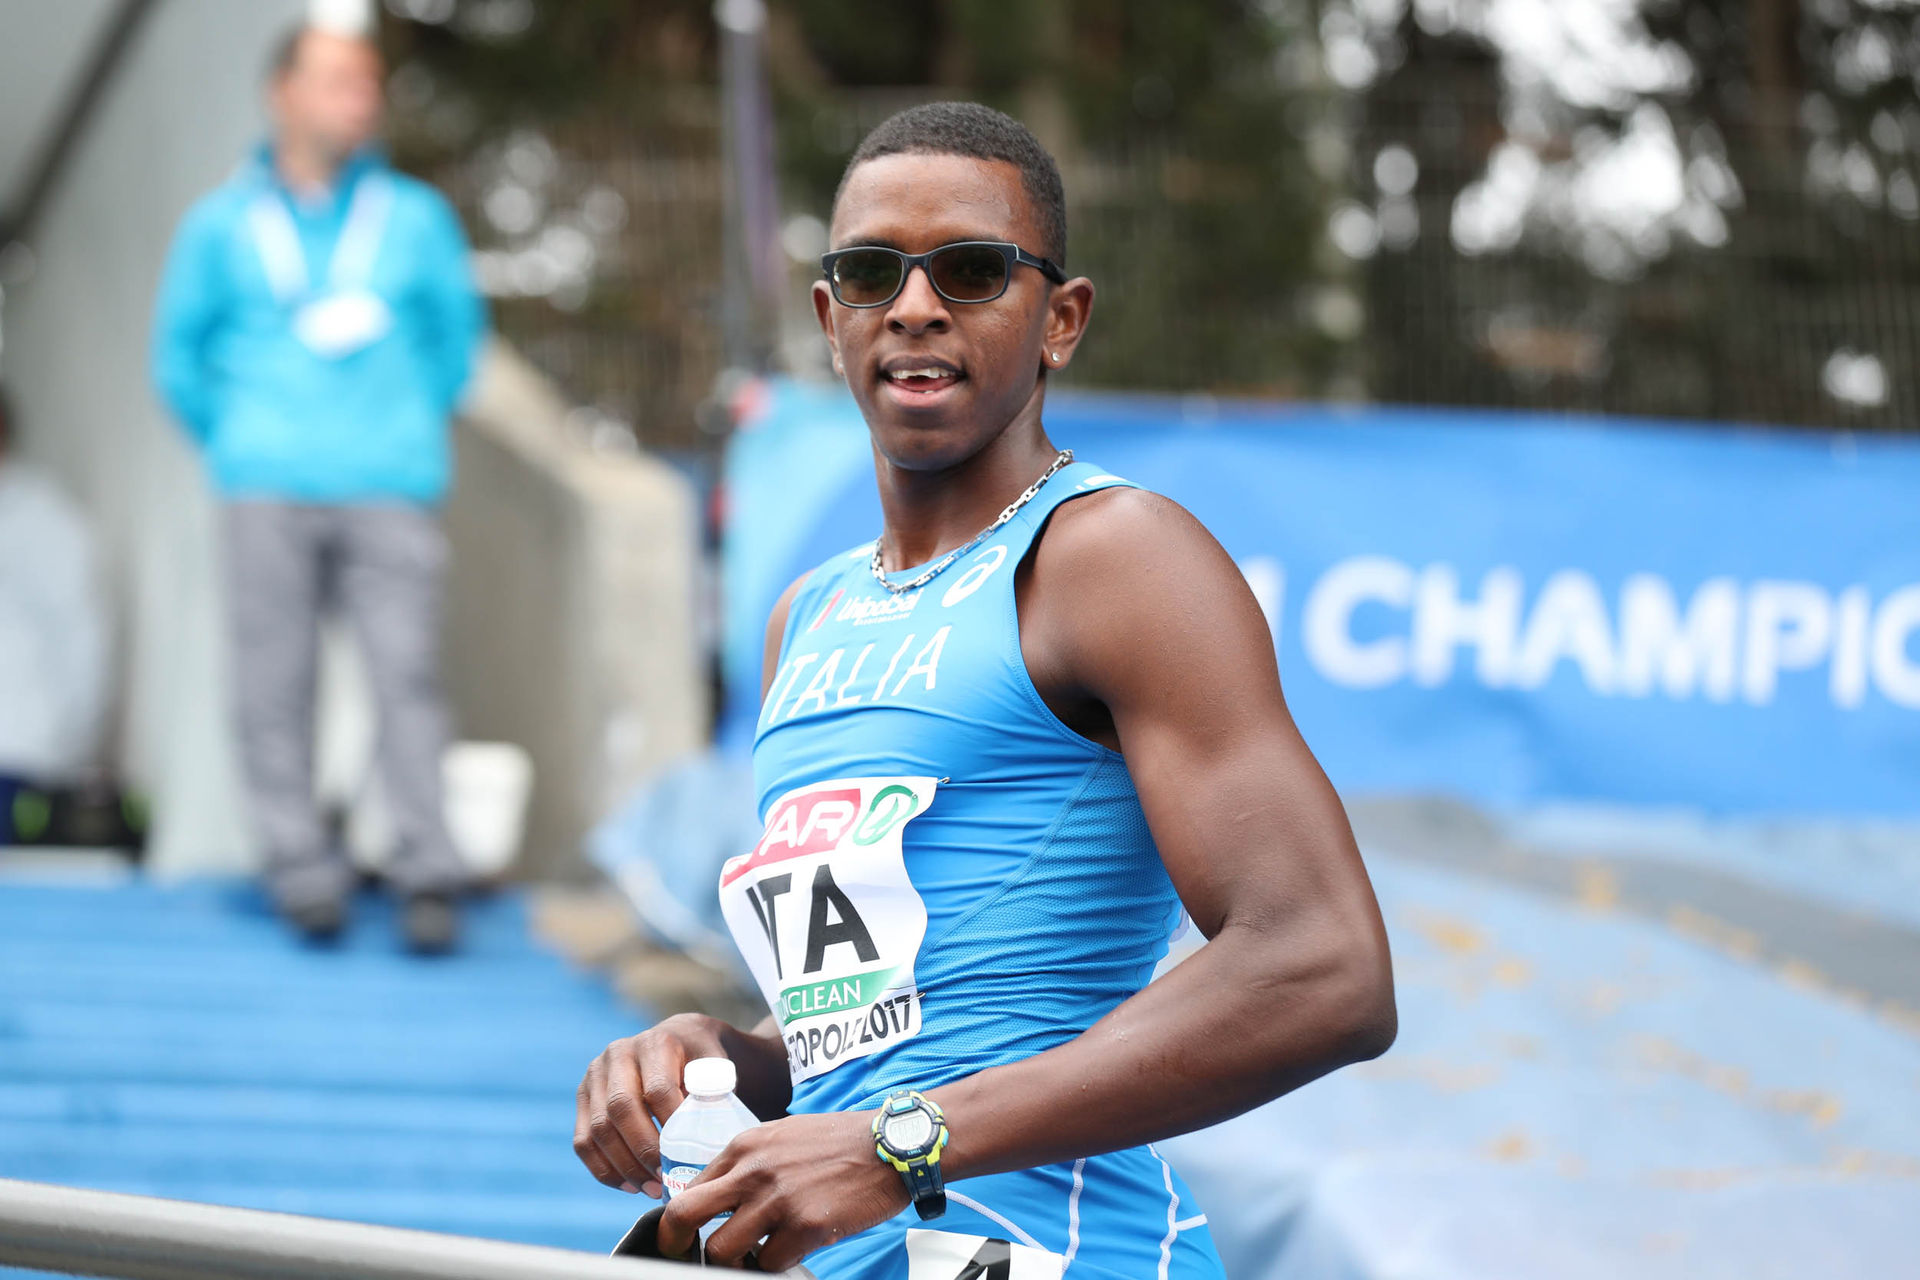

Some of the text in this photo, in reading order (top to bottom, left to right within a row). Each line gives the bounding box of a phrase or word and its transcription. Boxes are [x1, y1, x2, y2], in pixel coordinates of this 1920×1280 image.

[767, 625, 953, 724] ITALIA
[748, 800, 855, 860] AR
[745, 863, 880, 981] ITA
[662, 1174, 688, 1193] CRIST
